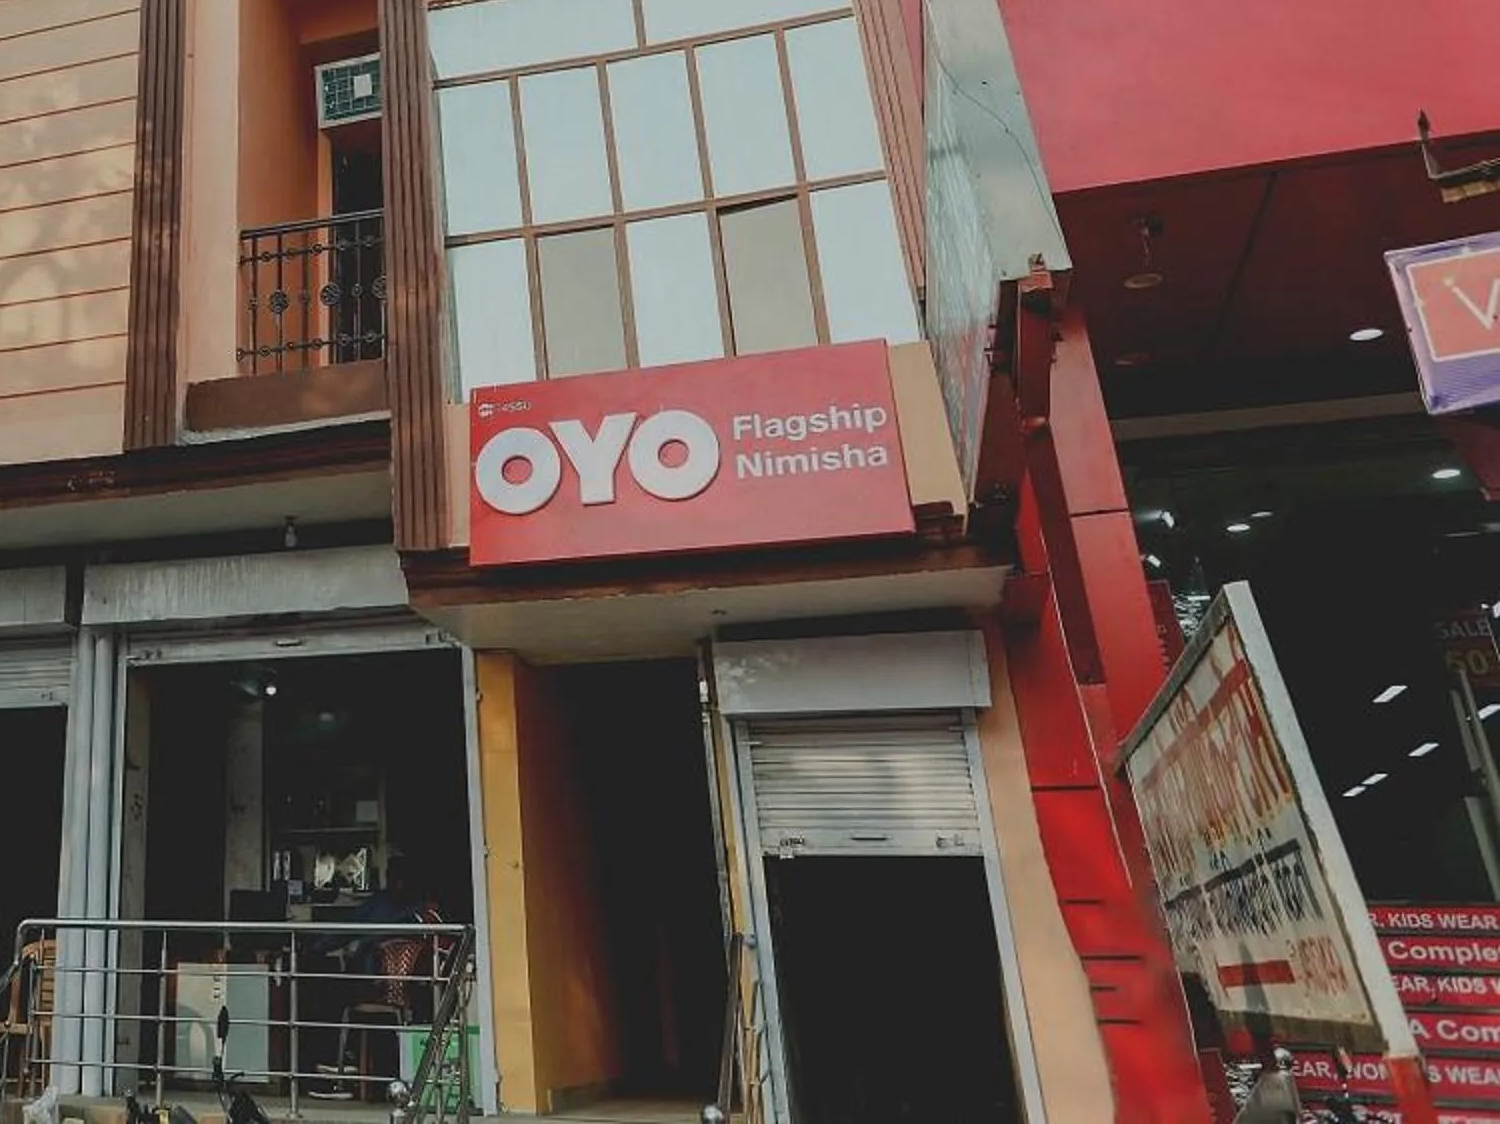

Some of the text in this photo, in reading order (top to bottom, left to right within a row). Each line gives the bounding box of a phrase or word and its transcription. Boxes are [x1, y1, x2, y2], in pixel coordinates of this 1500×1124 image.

[475, 402, 888, 515] OYO Flagship
[735, 443, 889, 479] Nimisha
[1387, 911, 1435, 930] KIDS
[1436, 912, 1500, 930] WEAR
[1386, 940, 1500, 965] Comple
[1437, 976, 1488, 995] KIDS
